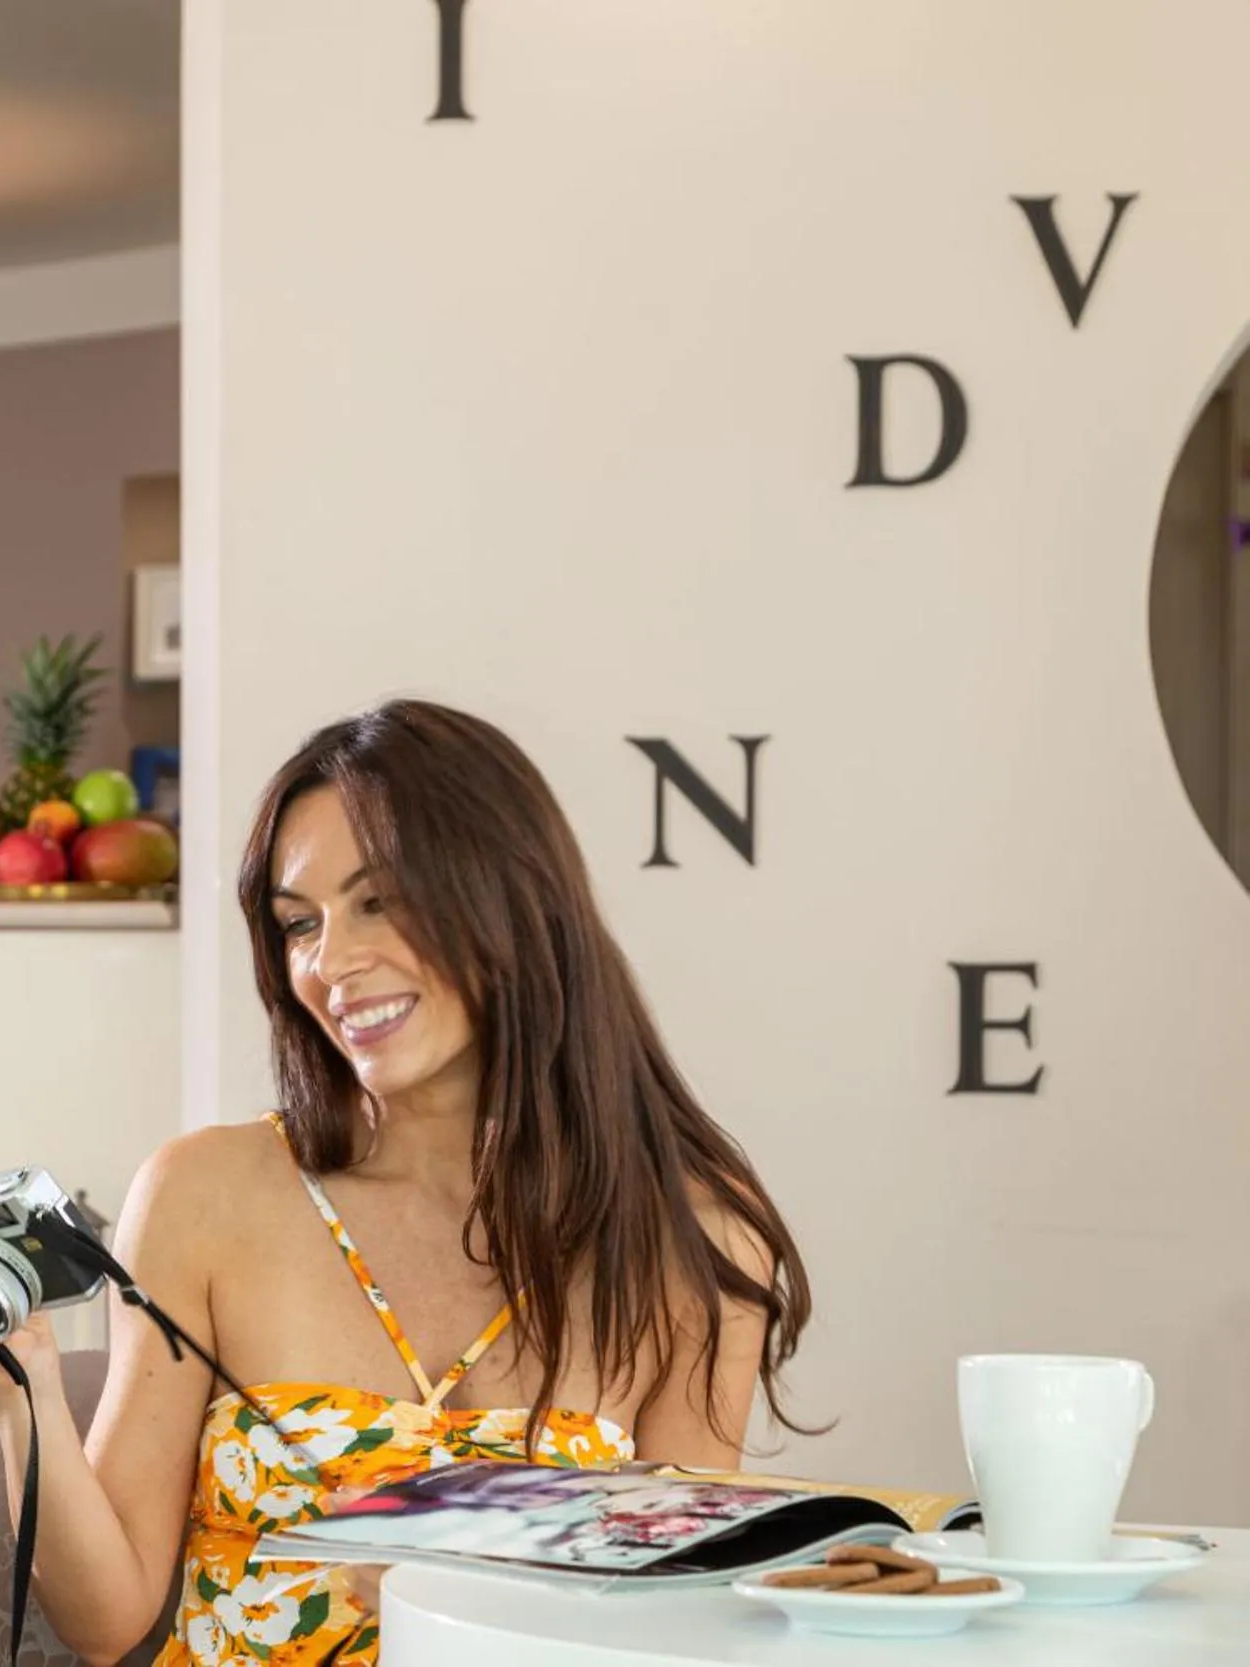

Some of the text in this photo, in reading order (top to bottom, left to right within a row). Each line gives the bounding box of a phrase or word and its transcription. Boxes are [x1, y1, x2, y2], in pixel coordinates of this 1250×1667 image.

[428, 0, 474, 122] I
[1010, 193, 1139, 329] V
[845, 354, 969, 488] D
[626, 735, 769, 868] N
[946, 961, 1046, 1096] E
